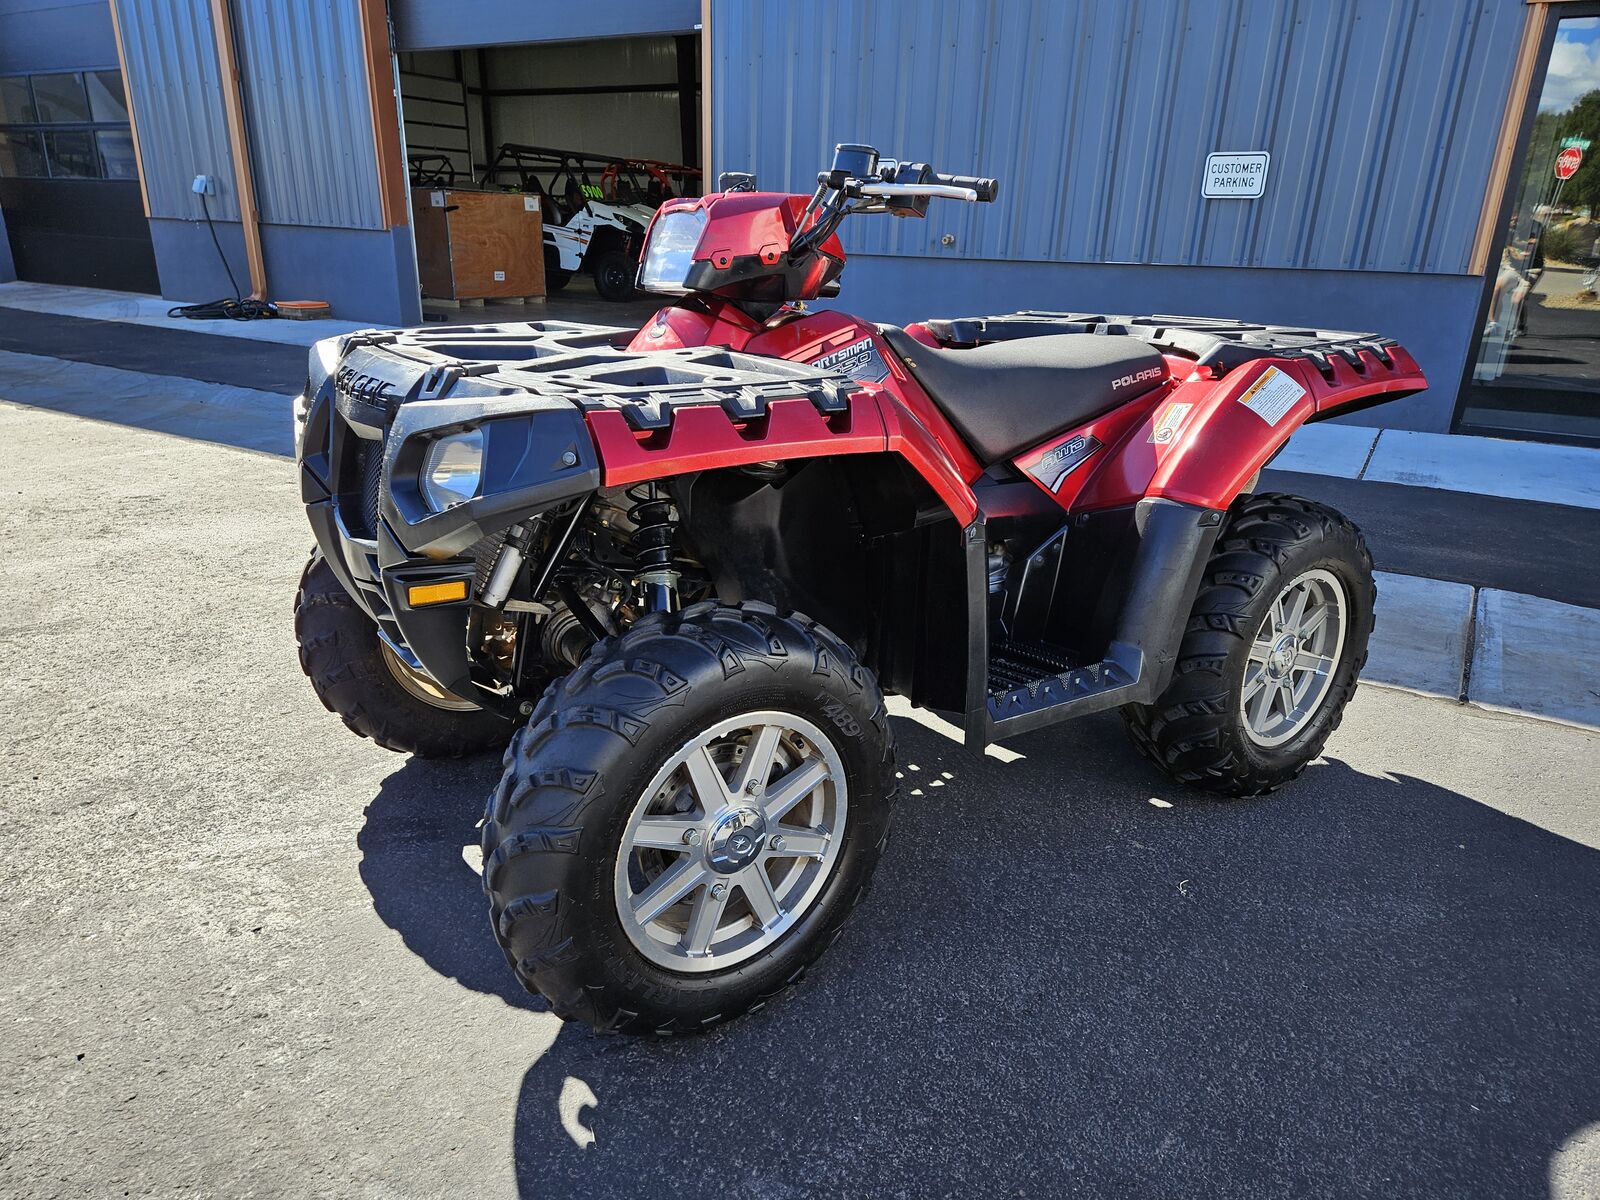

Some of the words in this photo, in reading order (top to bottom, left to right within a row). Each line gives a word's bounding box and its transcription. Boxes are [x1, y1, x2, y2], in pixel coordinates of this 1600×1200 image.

[1211, 162, 1263, 174] CUSTOMER
[1213, 176, 1256, 188] PARKING
[1111, 366, 1163, 391] POLARIS
